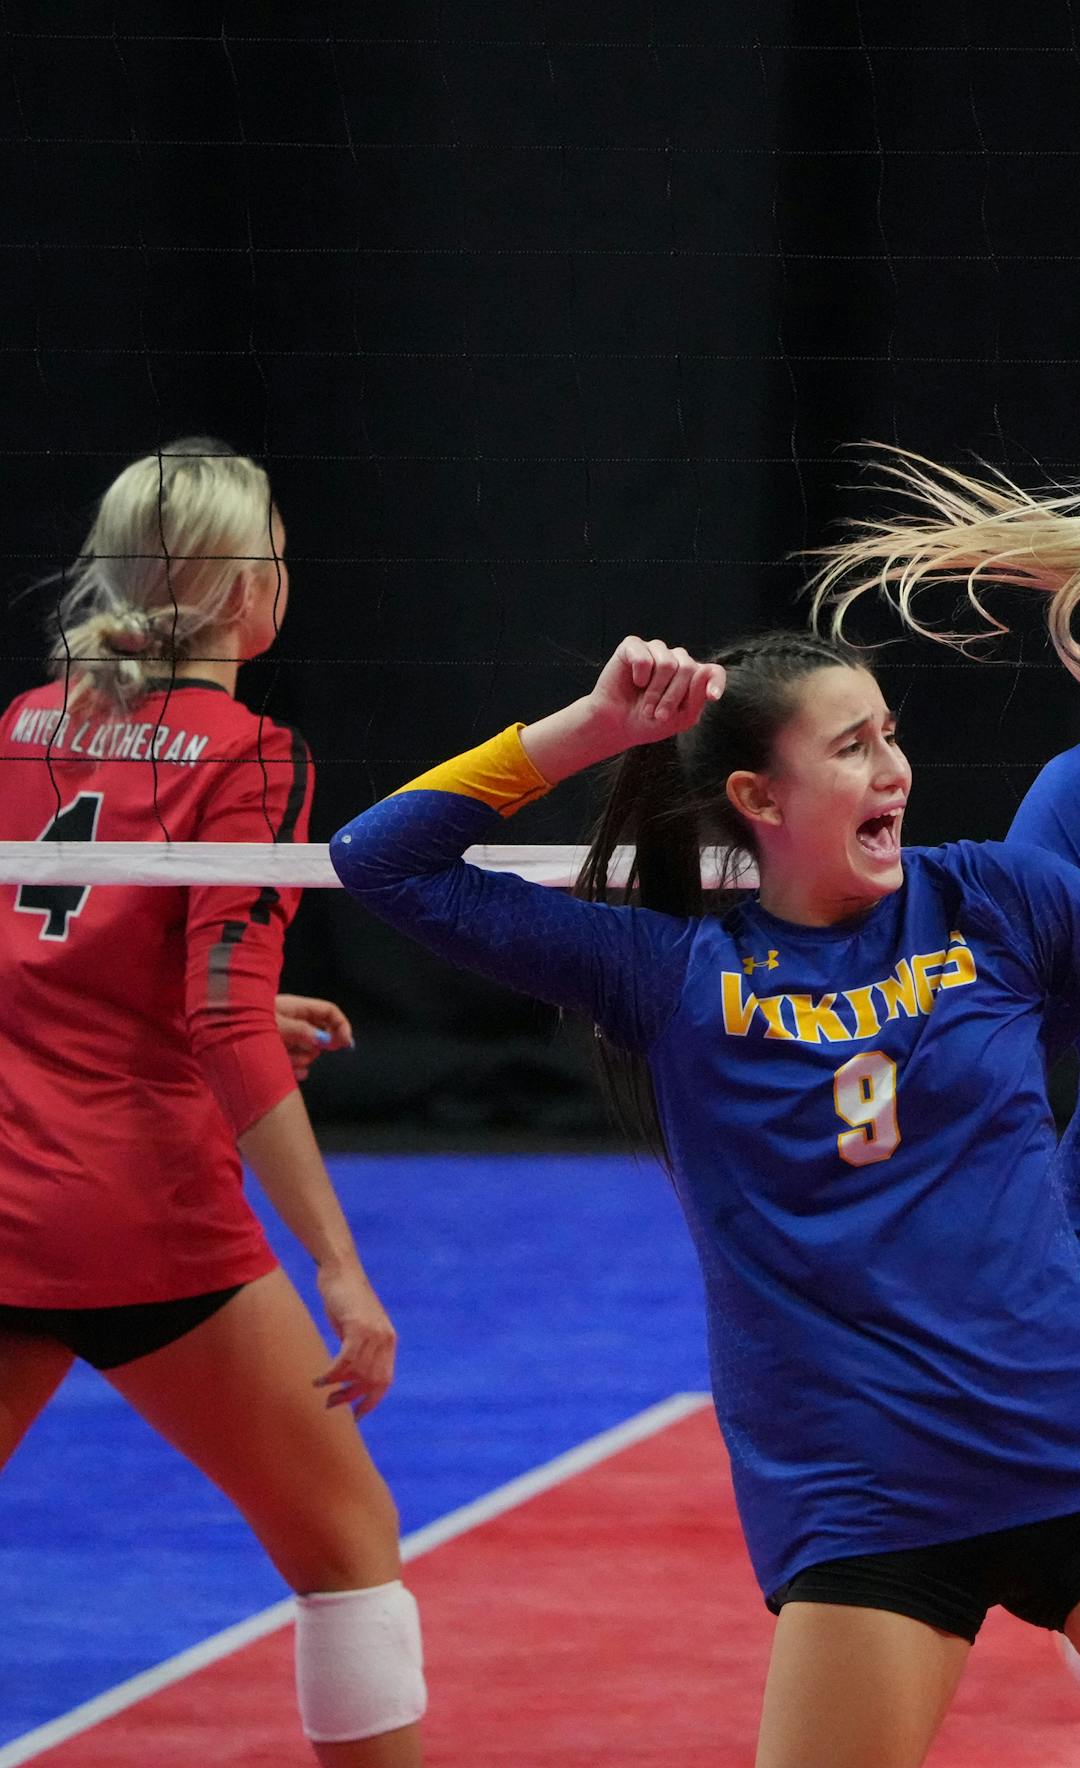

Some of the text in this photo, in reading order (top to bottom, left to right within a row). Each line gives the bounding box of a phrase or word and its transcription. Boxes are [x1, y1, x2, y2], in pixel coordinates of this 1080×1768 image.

[11, 707, 208, 768] MAYER LUTHERAN
[14, 791, 104, 942] 4
[833, 1050, 901, 1167] 9
